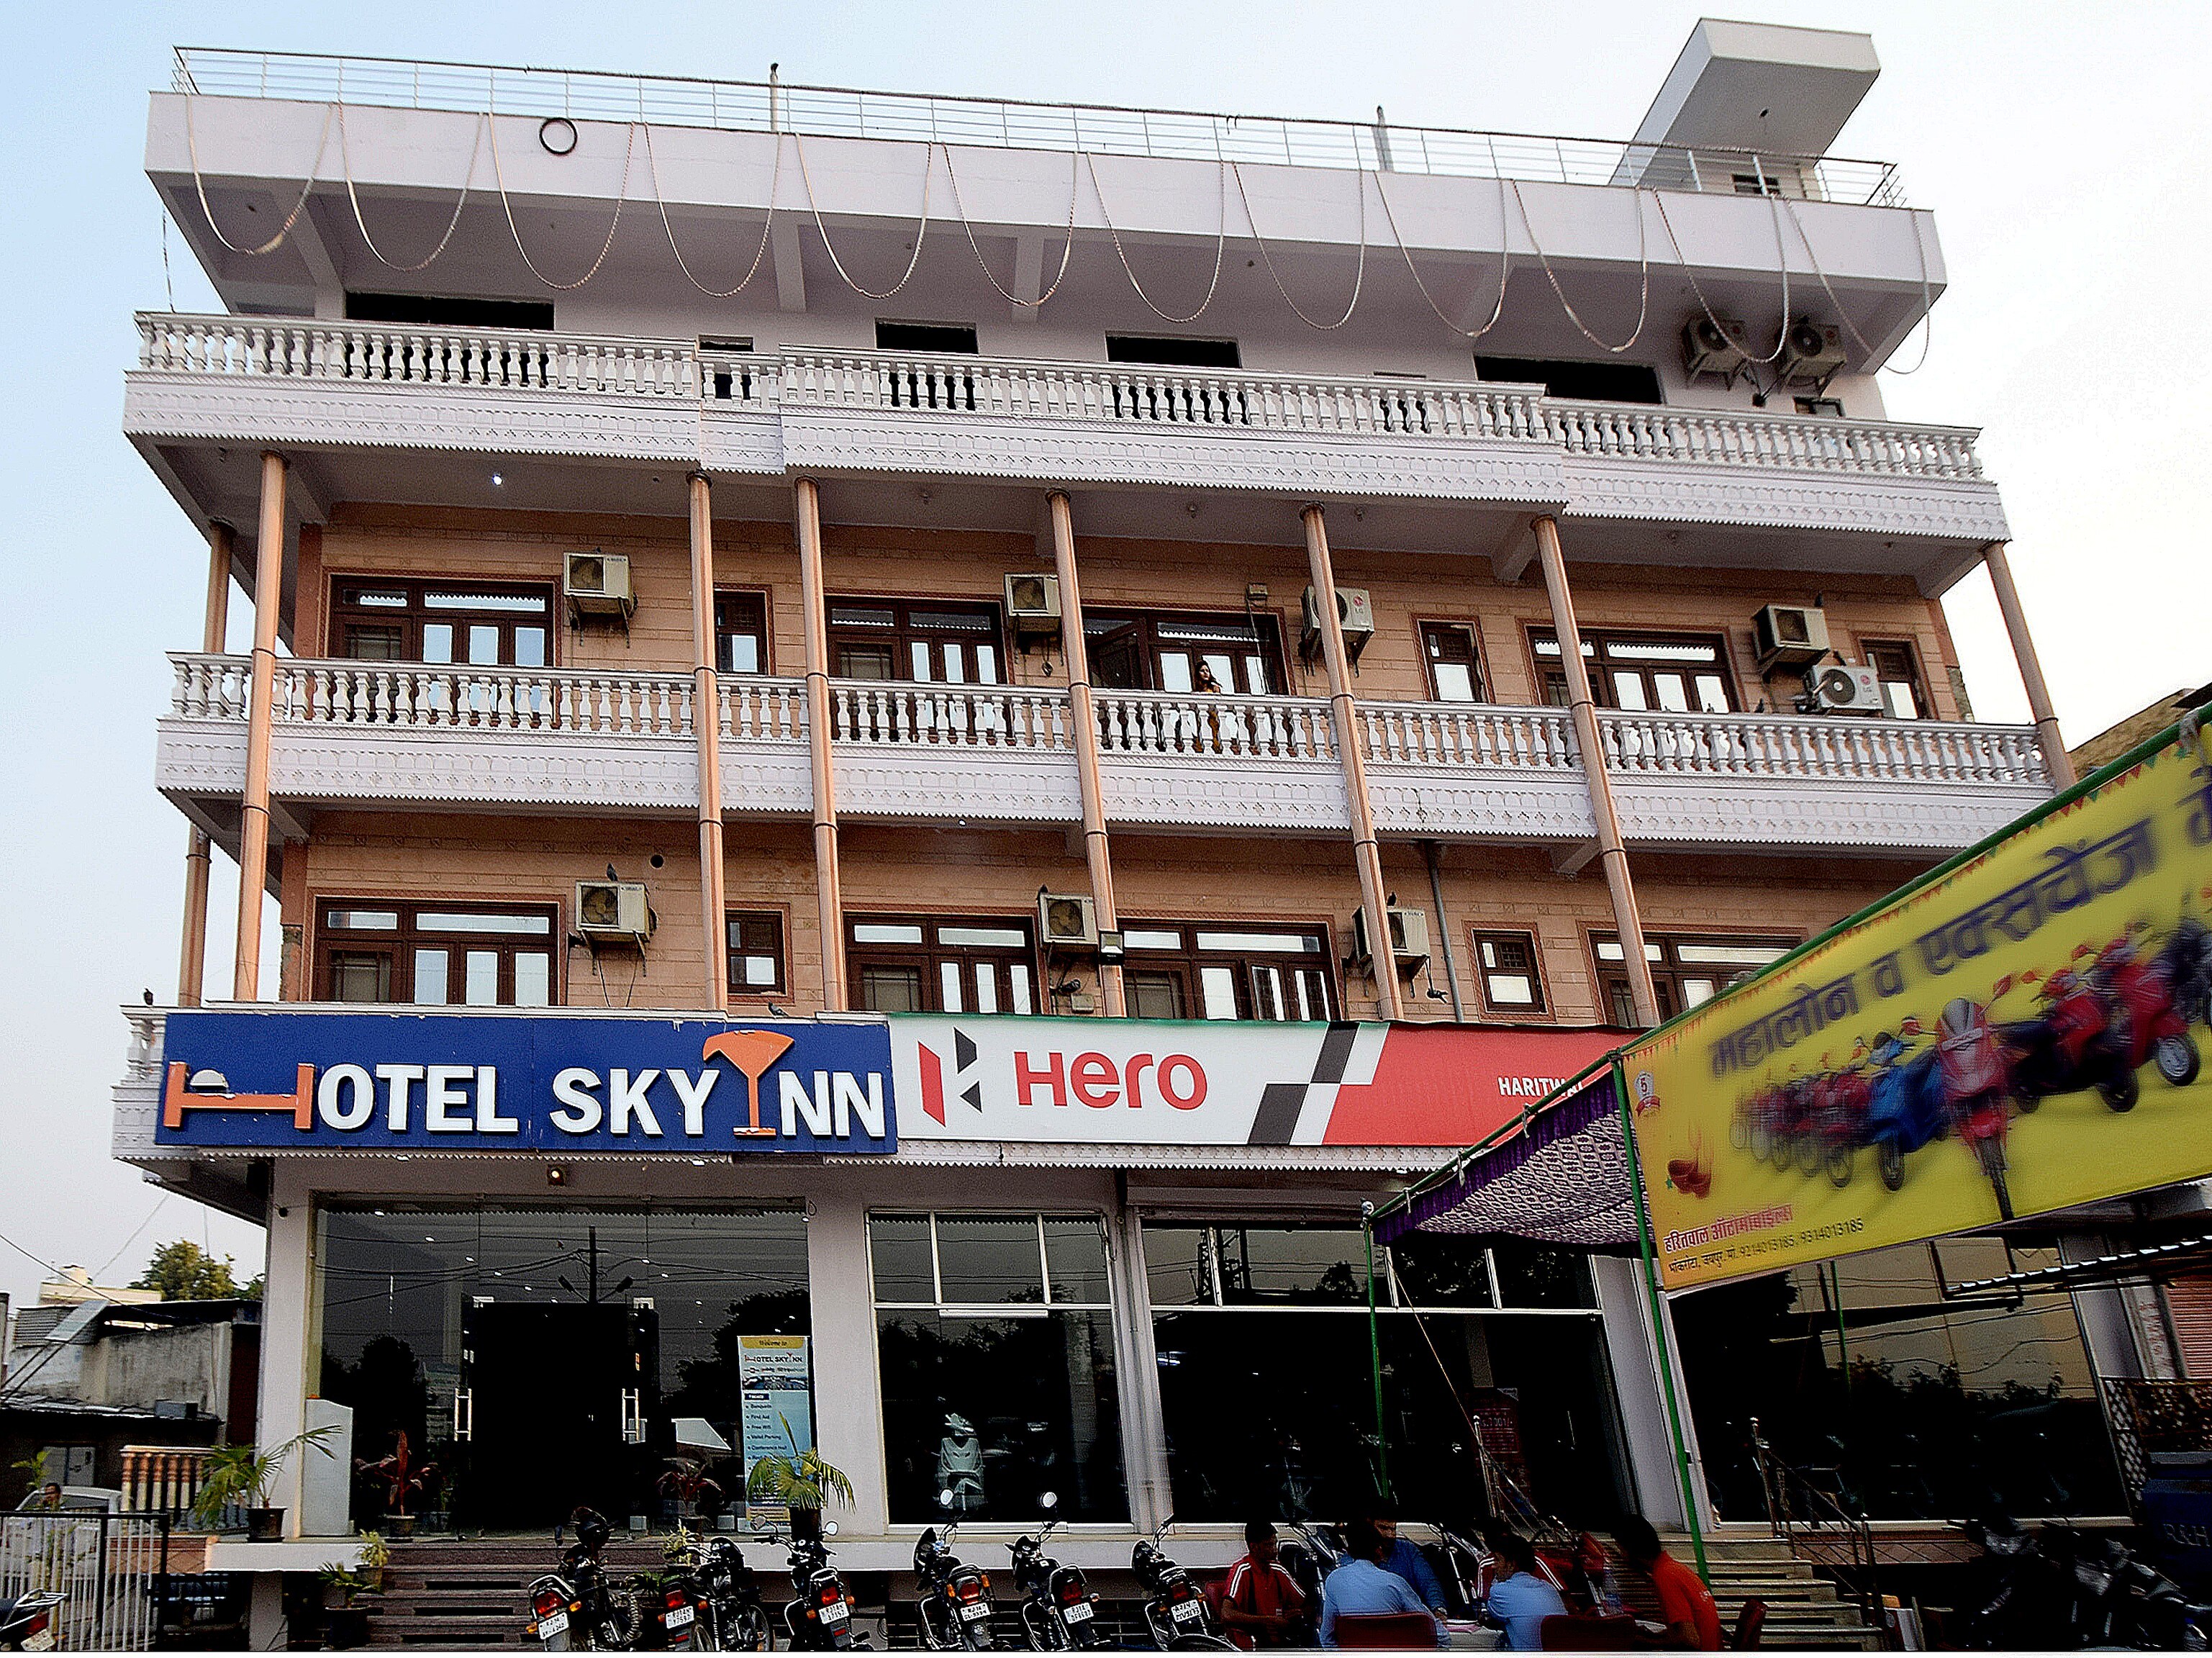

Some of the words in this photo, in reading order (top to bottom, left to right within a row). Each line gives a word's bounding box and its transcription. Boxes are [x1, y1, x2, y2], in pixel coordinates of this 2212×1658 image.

[1869, 948, 1905, 998] व
[163, 1061, 519, 1133] HOTEL
[548, 1066, 721, 1136] SKY
[1013, 1051, 1208, 1110] Hero
[1664, 1230, 1709, 1254] हरितवाल
